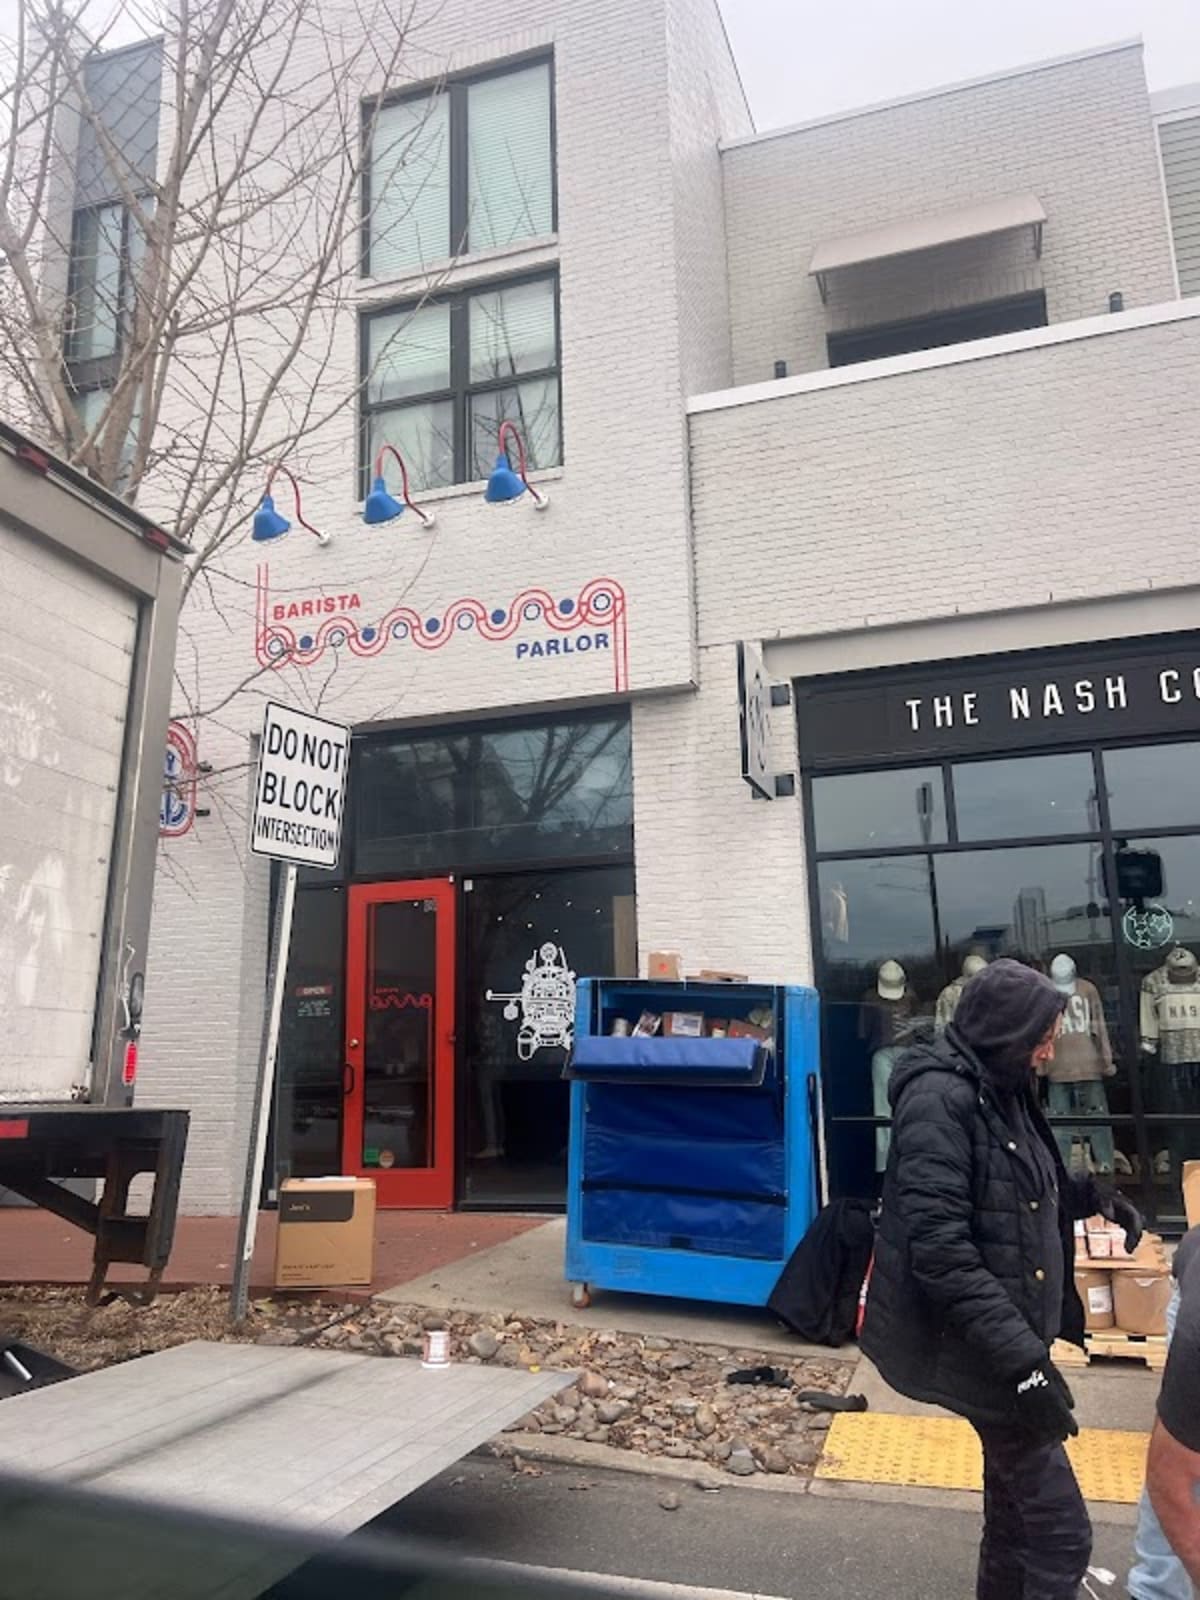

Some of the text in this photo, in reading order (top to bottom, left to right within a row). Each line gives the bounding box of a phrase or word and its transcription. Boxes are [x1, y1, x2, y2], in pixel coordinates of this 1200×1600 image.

[273, 594, 361, 620] BARISTA
[516, 633, 610, 659] PARLOR
[906, 693, 980, 731] THE
[1010, 675, 1128, 720] NASH
[268, 723, 345, 772] DO NOT
[262, 772, 339, 820] BLOCK
[258, 816, 336, 851] INTERSECTION
